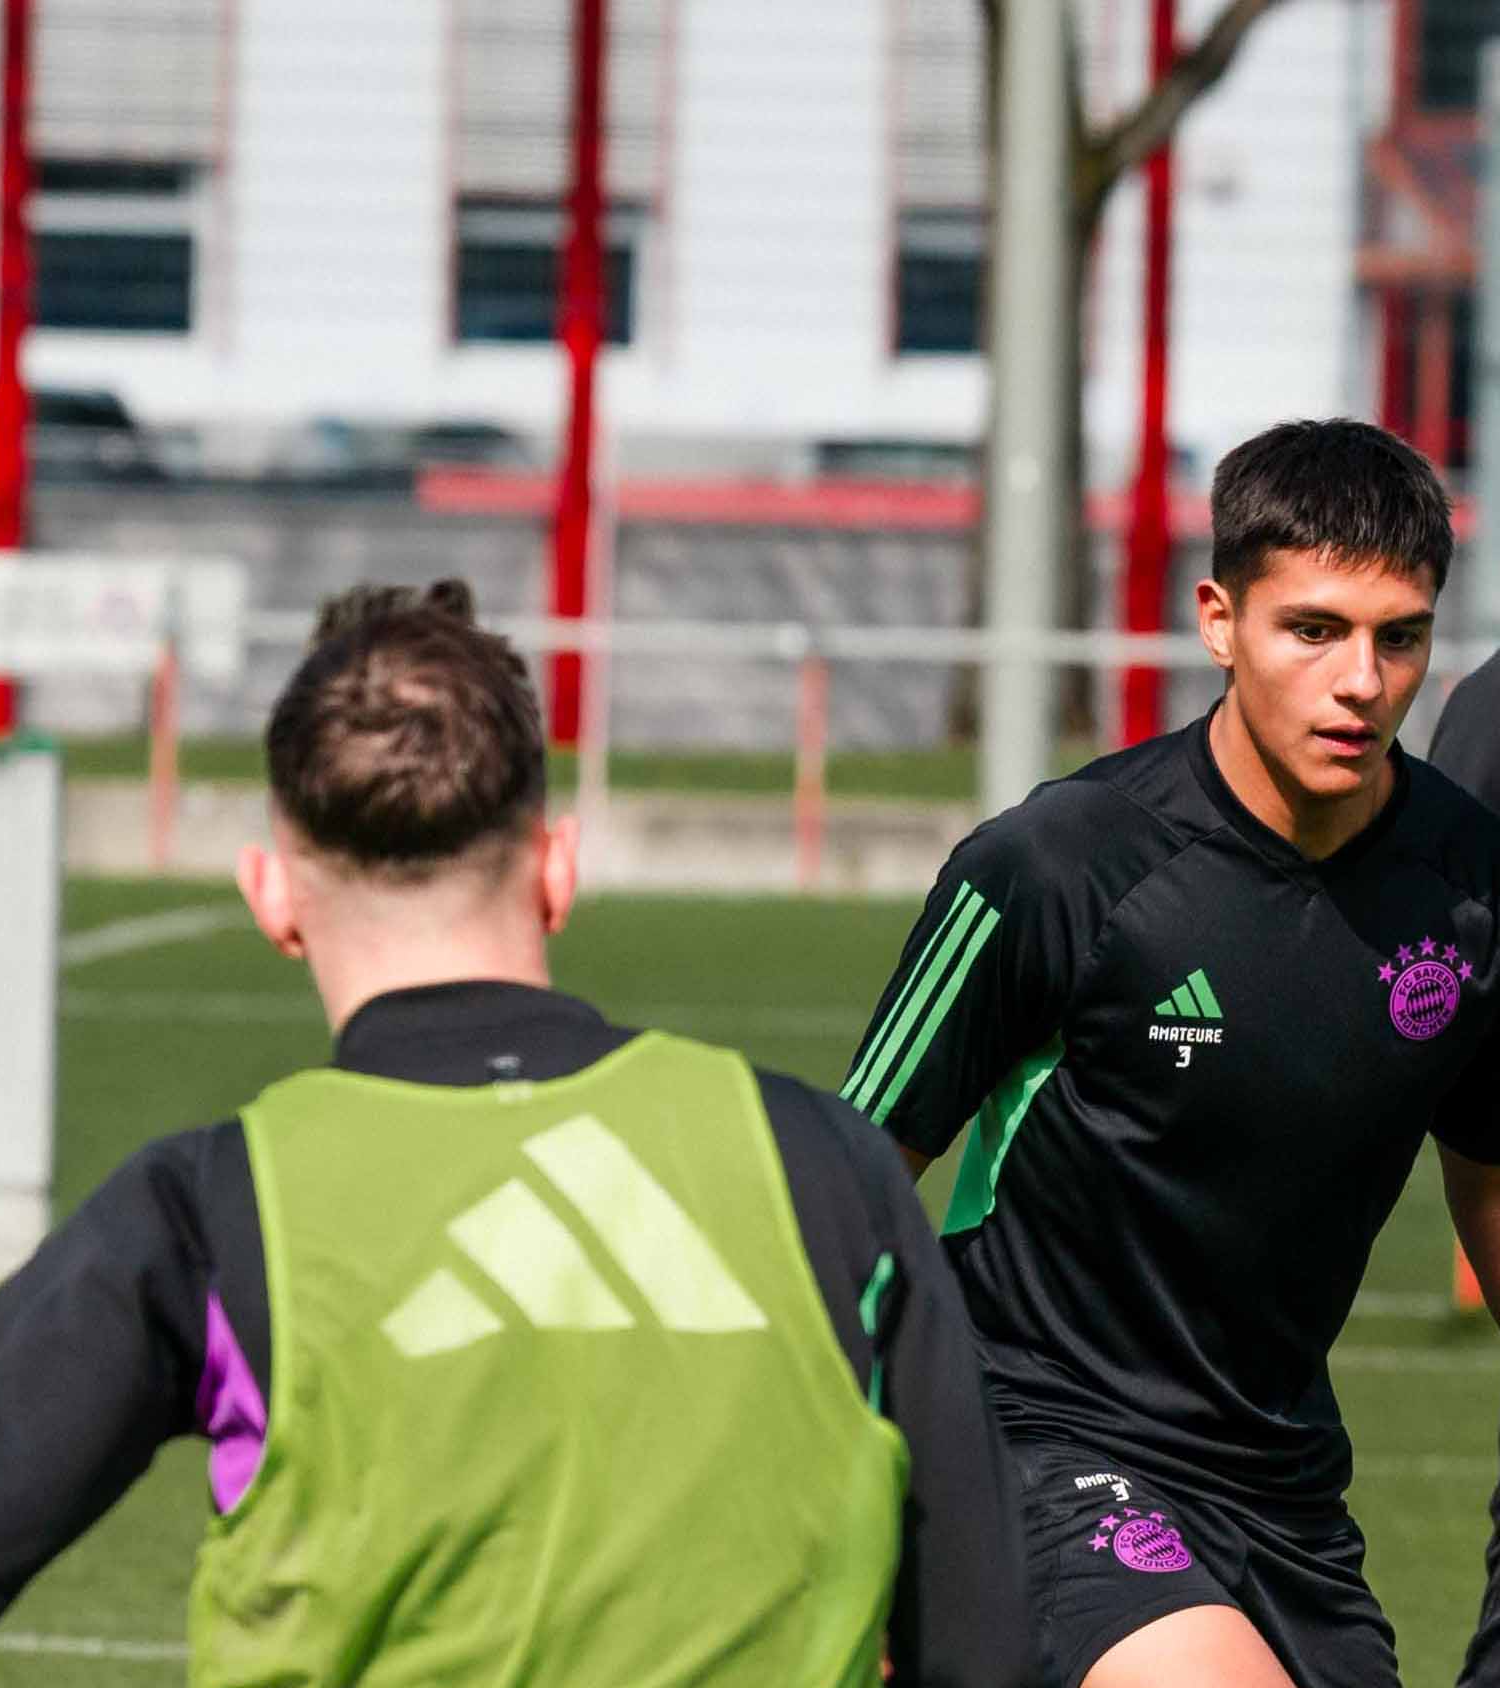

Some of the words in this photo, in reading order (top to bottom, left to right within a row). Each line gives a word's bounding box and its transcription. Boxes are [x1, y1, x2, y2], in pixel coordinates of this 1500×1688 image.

[1413, 967, 1455, 995] BAYERN
[1148, 1024, 1224, 1044] AMATEURE
[1175, 1045, 1192, 1068] 3
